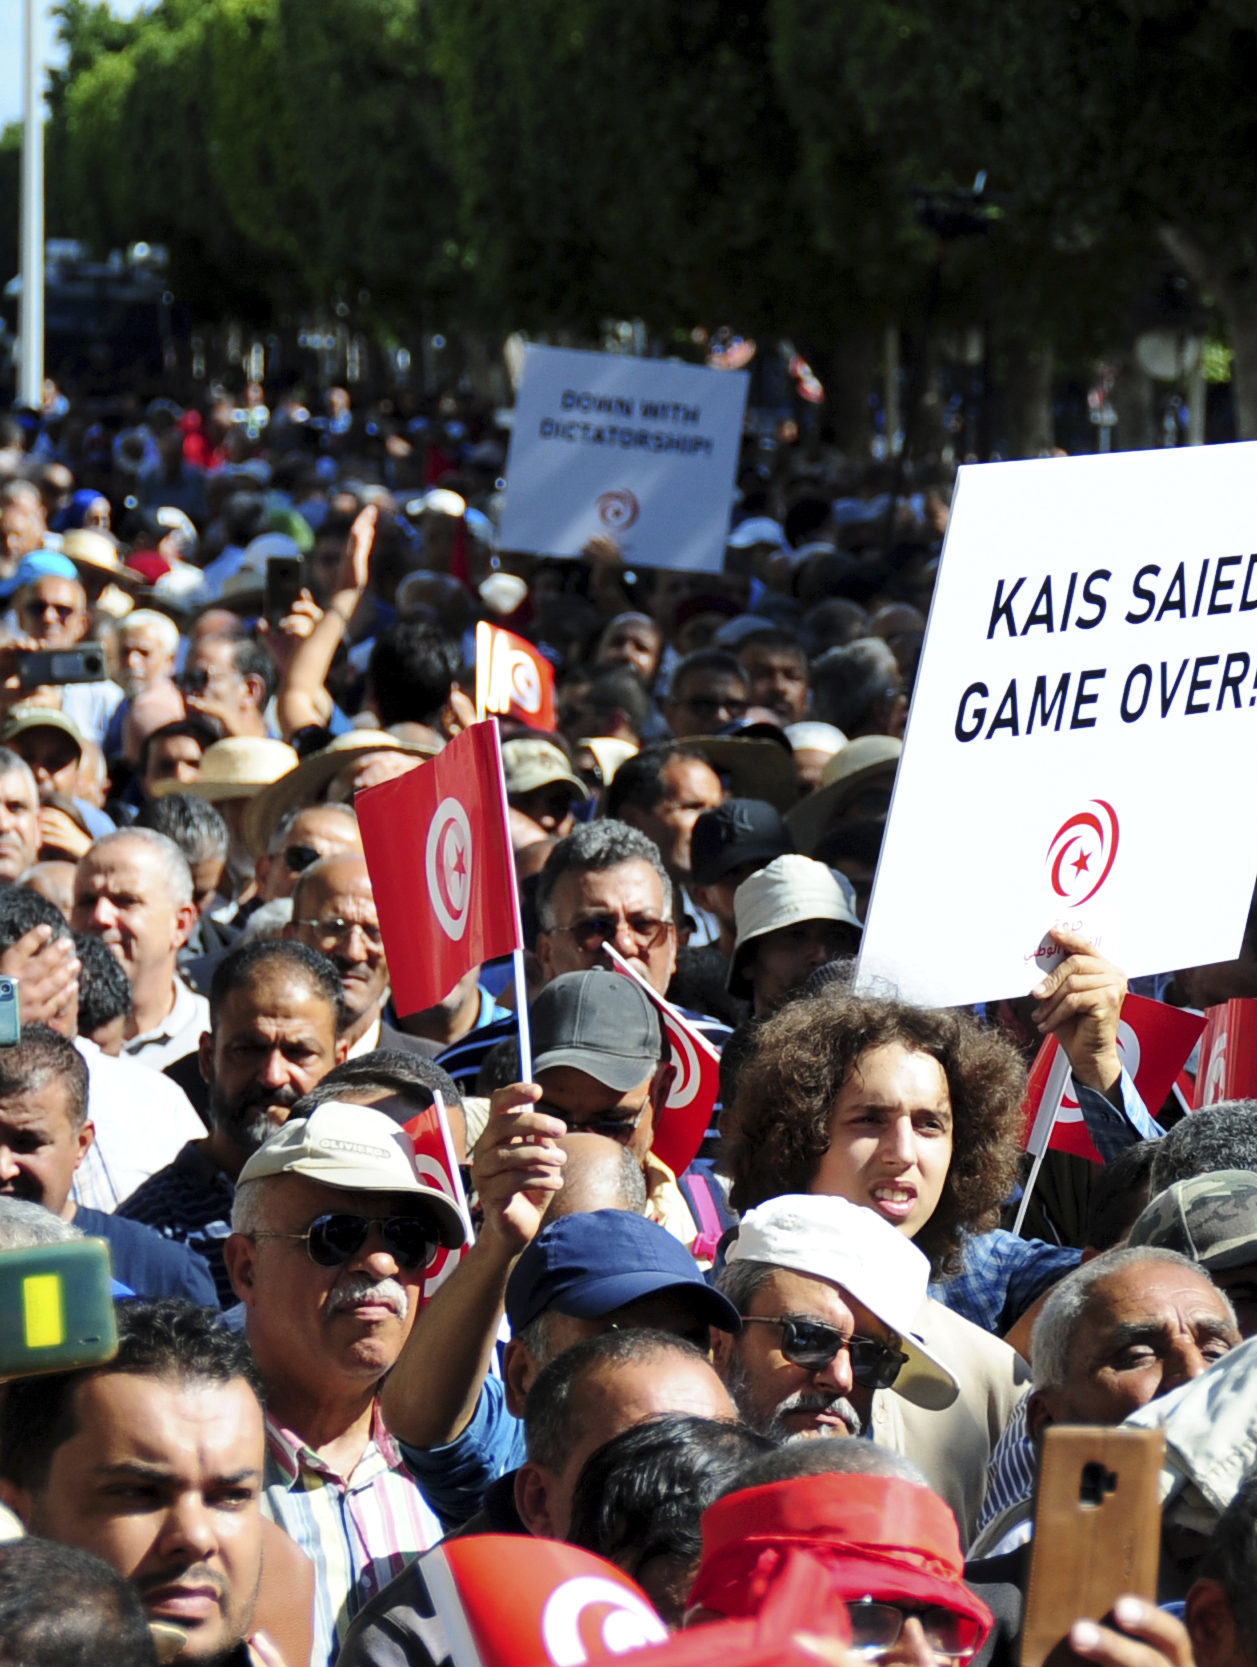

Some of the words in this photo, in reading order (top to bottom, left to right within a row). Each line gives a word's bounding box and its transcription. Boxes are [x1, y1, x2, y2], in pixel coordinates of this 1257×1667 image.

[561, 389, 635, 417] DOWN
[640, 400, 700, 424] WITH
[539, 417, 714, 456] DICTATORSHIP!
[986, 568, 1112, 639] KAIS
[954, 668, 1107, 743] GAME
